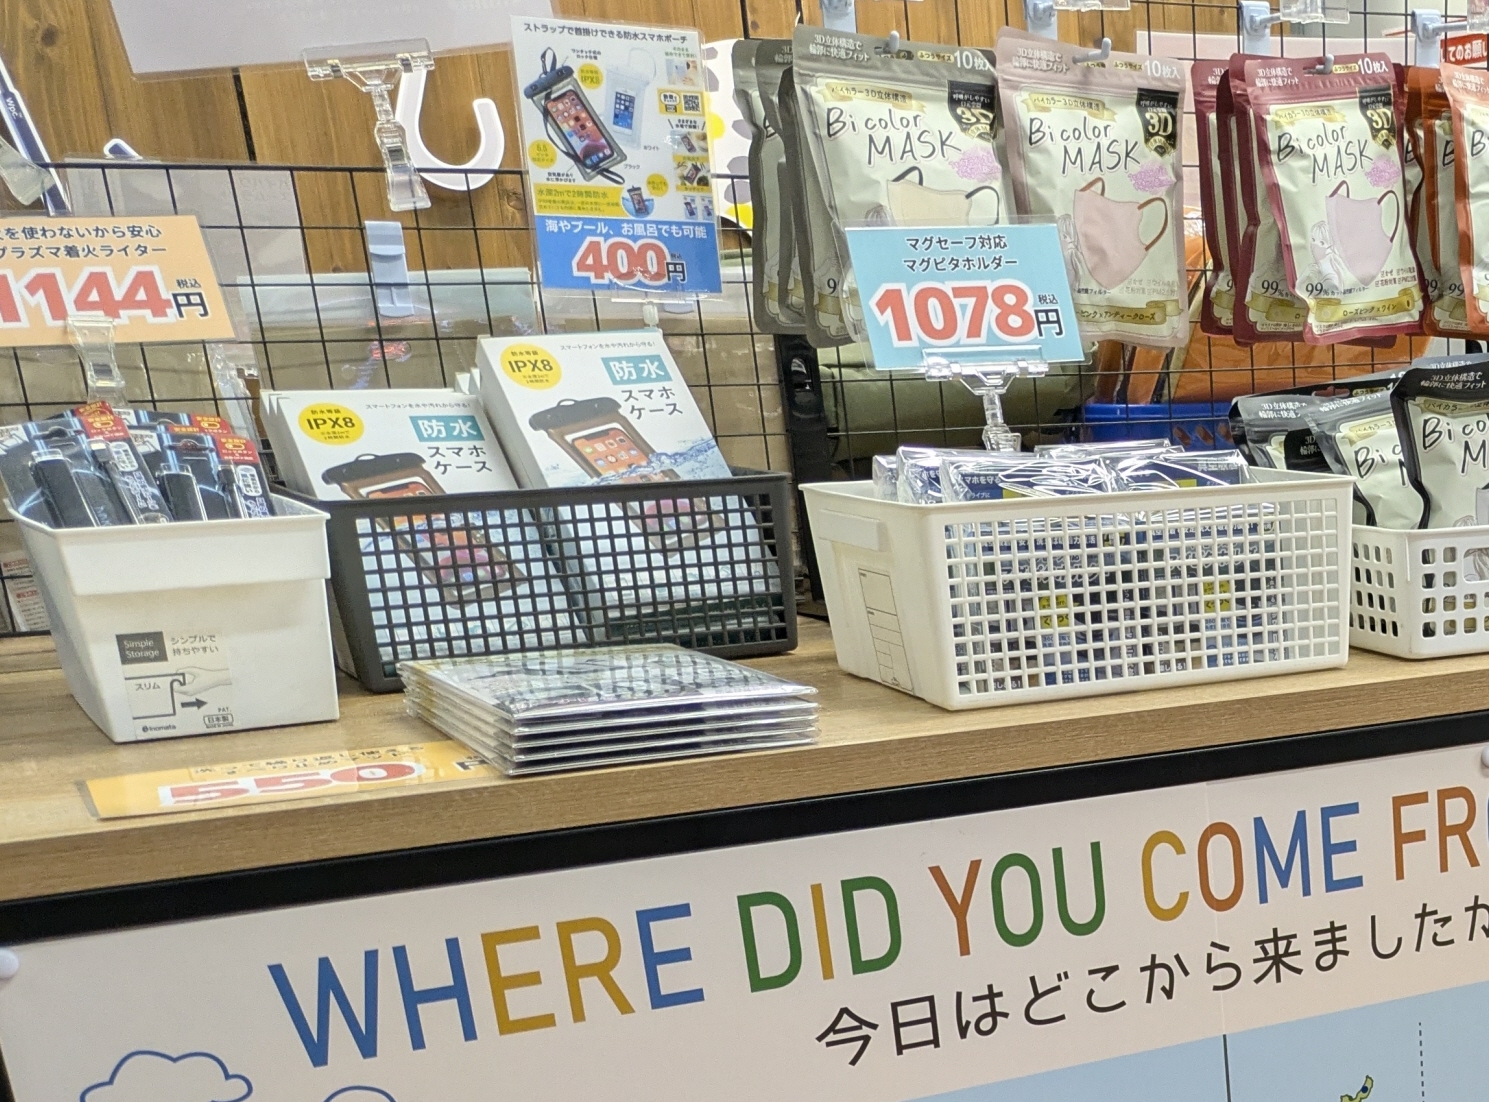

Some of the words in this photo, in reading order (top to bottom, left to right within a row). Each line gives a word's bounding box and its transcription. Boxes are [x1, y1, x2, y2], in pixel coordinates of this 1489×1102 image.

[524, 22, 688, 44] ストラップで首掛けできる防水スマホポーチ
[1144, 59, 1181, 80] 10枚入
[1358, 57, 1389, 75] 10枚入
[956, 107, 995, 125] 3D
[1145, 113, 1173, 136] 3D
[1366, 109, 1392, 129] 3D
[867, 130, 962, 166] MASK
[1062, 139, 1141, 175] MASK
[1312, 139, 1373, 184] MASK
[0, 224, 162, 242] を使わないから安心
[545, 219, 707, 239] 海やプール、お風呂でも可能
[906, 235, 1008, 251] マグセーフ対応
[576, 239, 667, 283] 400
[903, 255, 1018, 272] マグピタホルダー
[665, 261, 687, 283] 円
[176, 279, 202, 289] 税込
[172, 293, 210, 319] 円
[1037, 294, 1059, 304] 税込
[875, 284, 1036, 343] 1078
[1034, 307, 1064, 337] 円
[508, 359, 554, 373] IPX8
[609, 359, 666, 382] 防水
[1431, 371, 1483, 382] 3D立体構造で
[620, 386, 676, 403] スマホ
[629, 402, 684, 420] ケース
[306, 417, 355, 430] IPX8
[417, 418, 477, 438] 防水
[427, 445, 487, 459] スマホ
[433, 460, 493, 476] ケース
[124, 639, 154, 649] Simple
[170, 634, 216, 646] シンプルで
[125, 649, 160, 659] Storage
[172, 646, 219, 656] 持ちやすい
[135, 682, 161, 691] スリム
[170, 762, 417, 803] 550
[267, 902, 706, 1069] WHERE
[736, 875, 903, 994] DID
[928, 841, 1107, 959] YOU
[1140, 802, 1364, 923] COME
